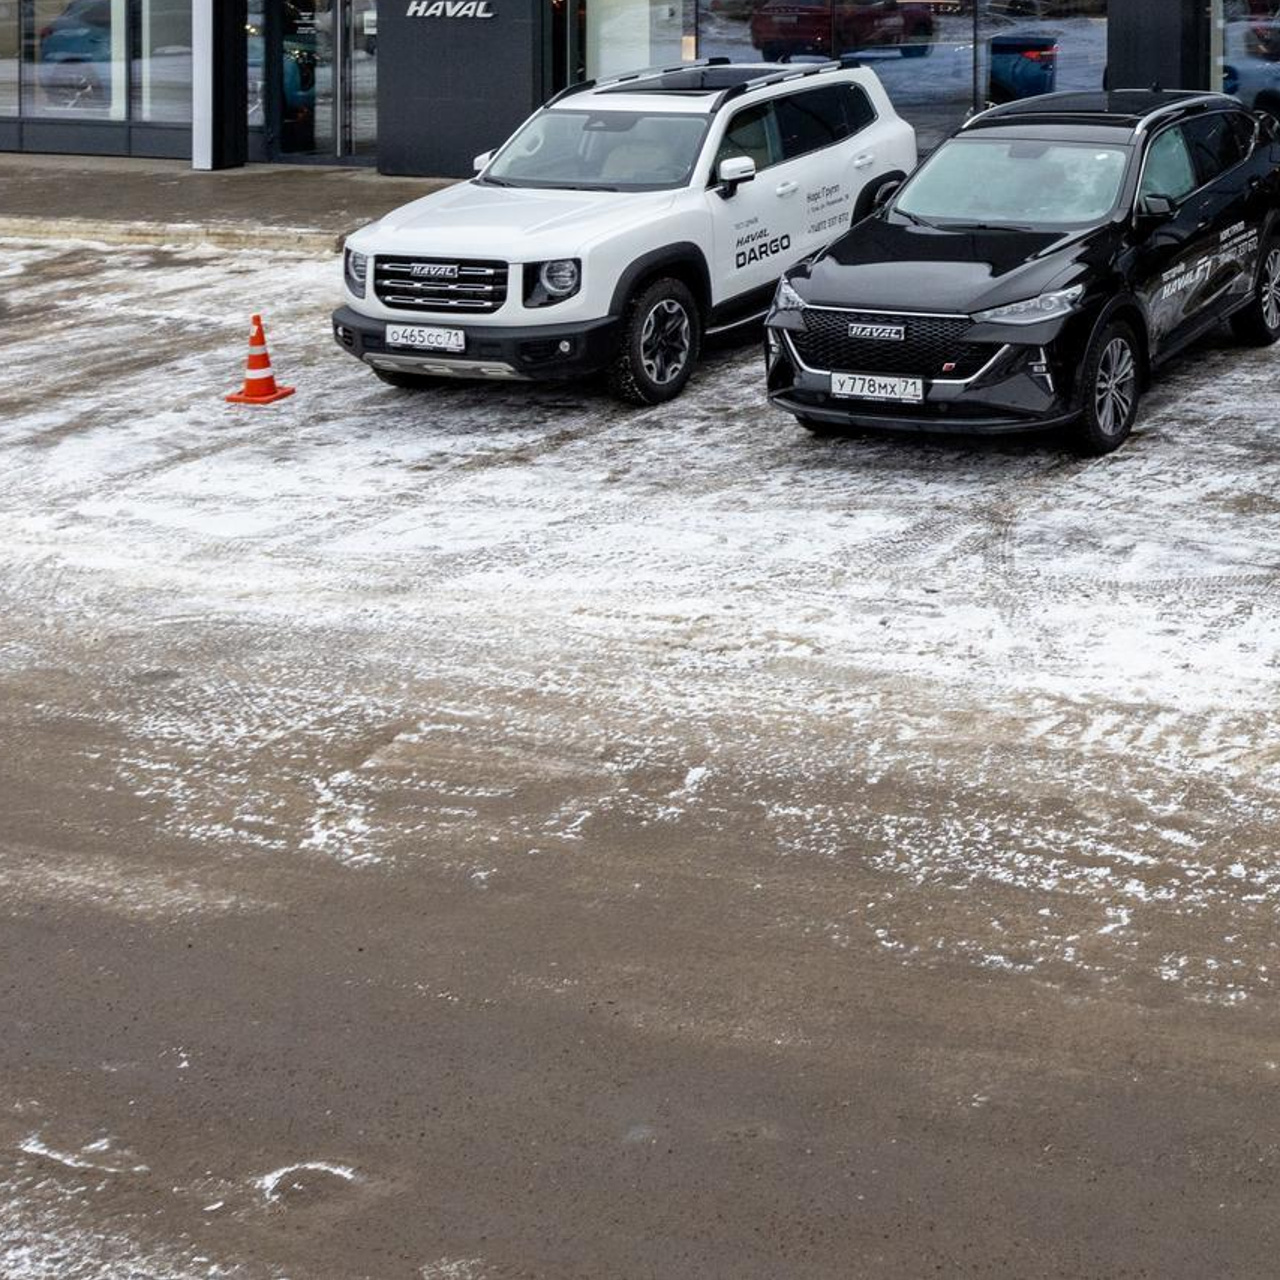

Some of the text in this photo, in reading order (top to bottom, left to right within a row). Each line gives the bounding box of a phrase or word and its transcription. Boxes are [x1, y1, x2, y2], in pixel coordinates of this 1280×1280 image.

[406, 0, 494, 17] HAVAL
[736, 229, 769, 248] HAVAL
[736, 234, 791, 269] DARGO
[412, 266, 455, 276] HAVAL
[852, 326, 900, 338] HAVAL
